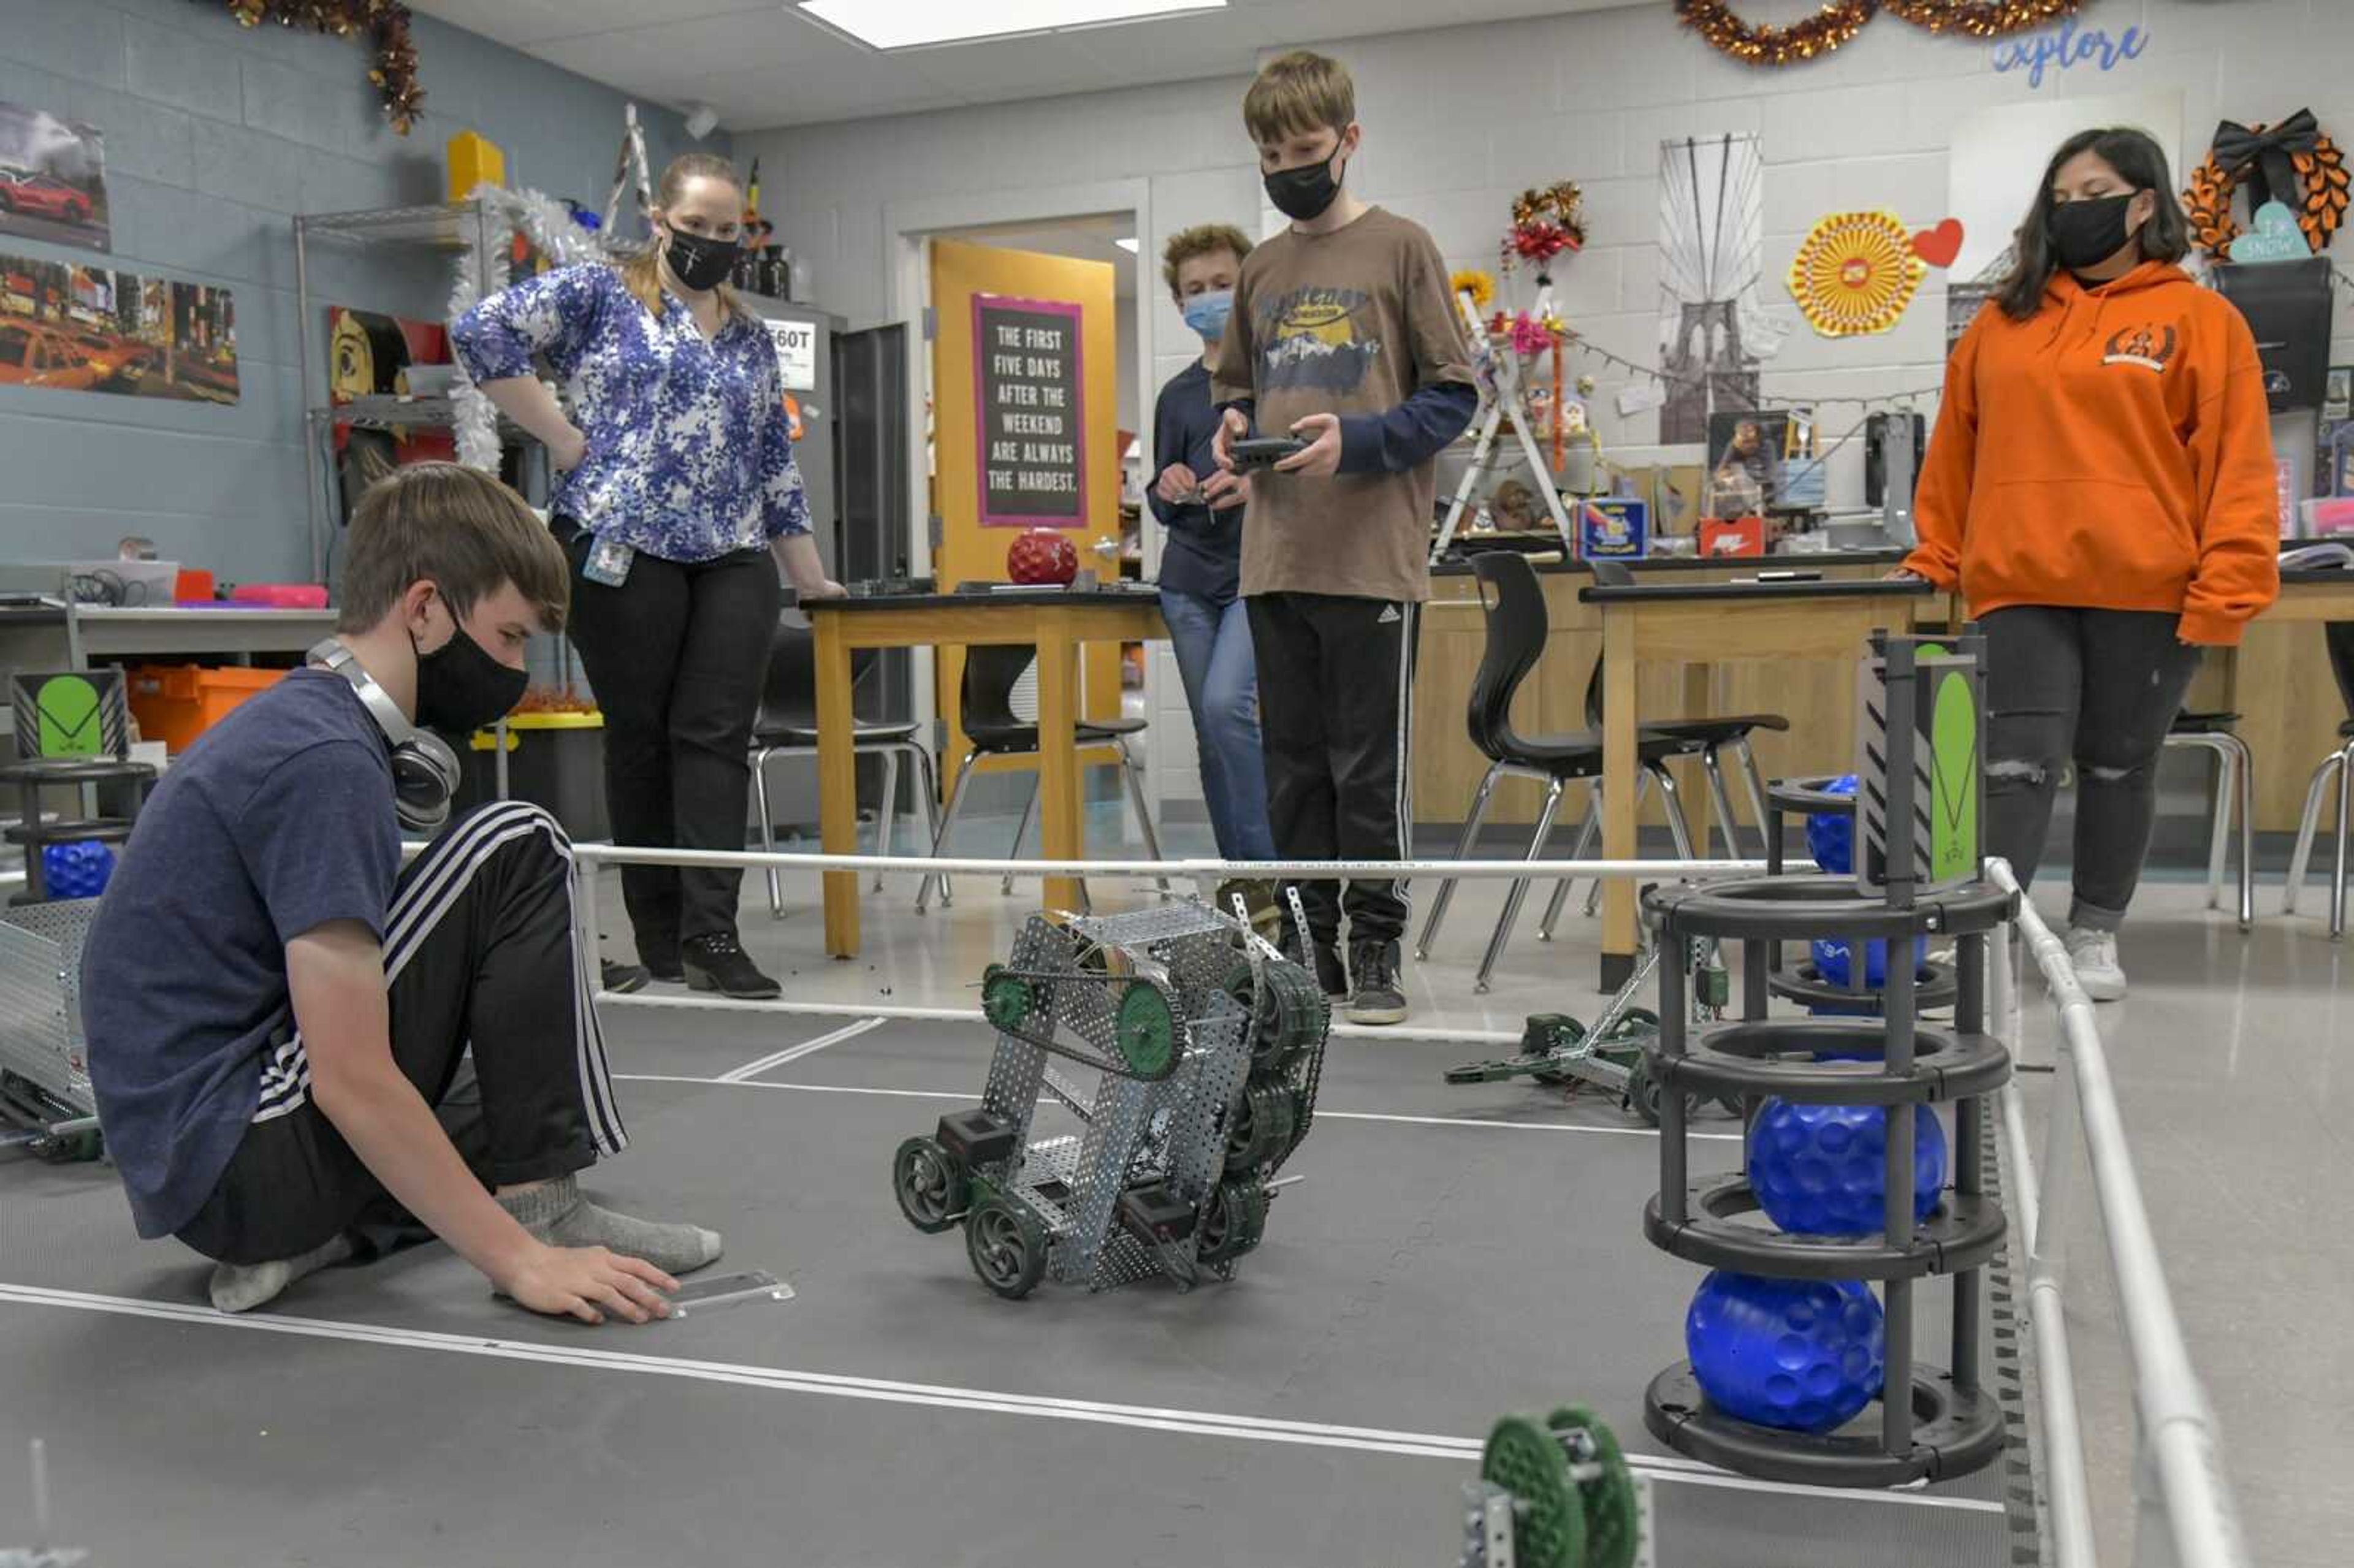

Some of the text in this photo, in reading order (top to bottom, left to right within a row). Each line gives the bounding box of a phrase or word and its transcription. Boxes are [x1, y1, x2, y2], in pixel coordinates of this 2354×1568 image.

[2246, 238, 2295, 257] SNOW
[997, 325, 1061, 350] THE FIRST
[994, 354, 1061, 378] FIVE DAYS
[998, 384, 1065, 407] AFTER THE
[1002, 412, 1063, 435] WEEKEND
[991, 441, 1073, 464] ARE ALWAYS
[988, 470, 1078, 492] THE HARDEST.
